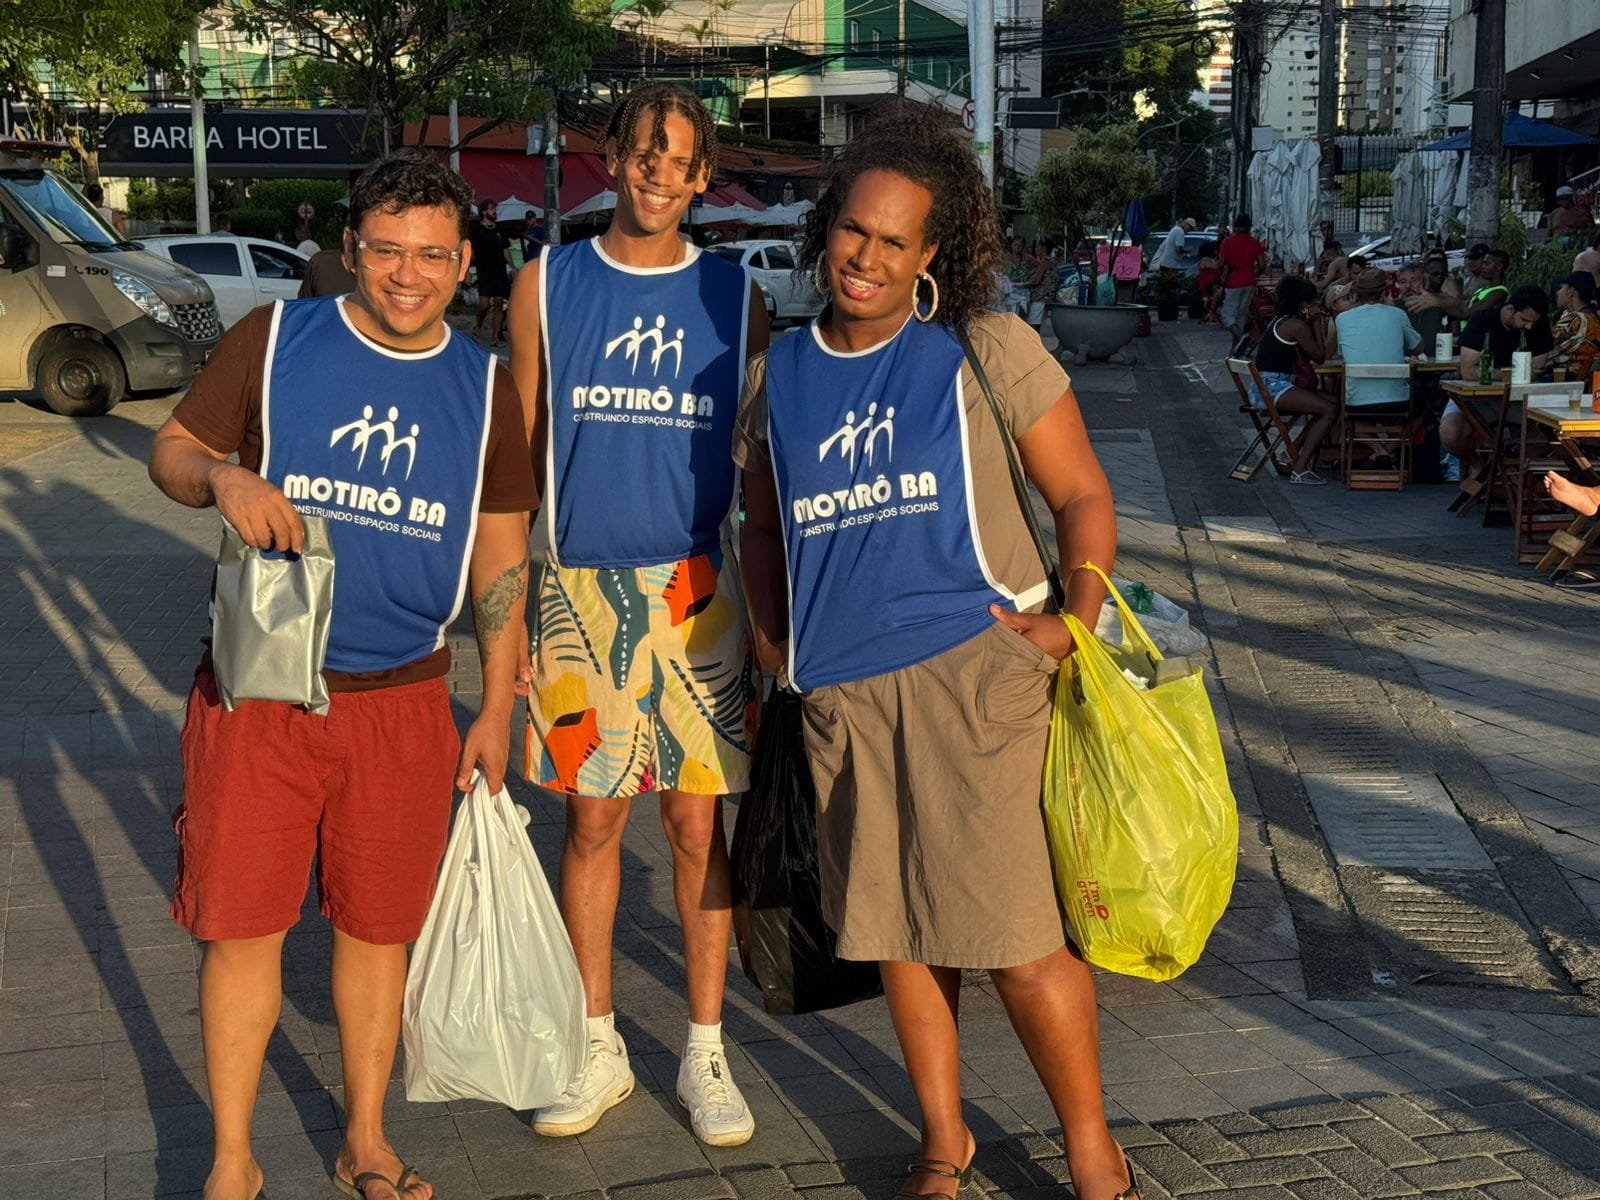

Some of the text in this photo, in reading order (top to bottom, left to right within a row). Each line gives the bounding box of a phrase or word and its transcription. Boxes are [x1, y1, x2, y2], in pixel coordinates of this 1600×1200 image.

[237, 126, 327, 150] HOTEL
[85, 266, 109, 276] 190
[680, 393, 714, 417] BA
[573, 412, 712, 430] CSTRUINDO ESPAÇOS SOCIAIS
[283, 474, 446, 527] MOTIRÔ BA
[793, 471, 938, 524] MOTIRÔ BA
[292, 504, 442, 542] ONSTRUINDO ESPAÇOS SOCIAIS
[857, 507, 898, 525] ESPÇOS
[899, 501, 939, 515] SOCIAIS
[1076, 880, 1096, 918] green
[1088, 880, 1100, 902] I'm
